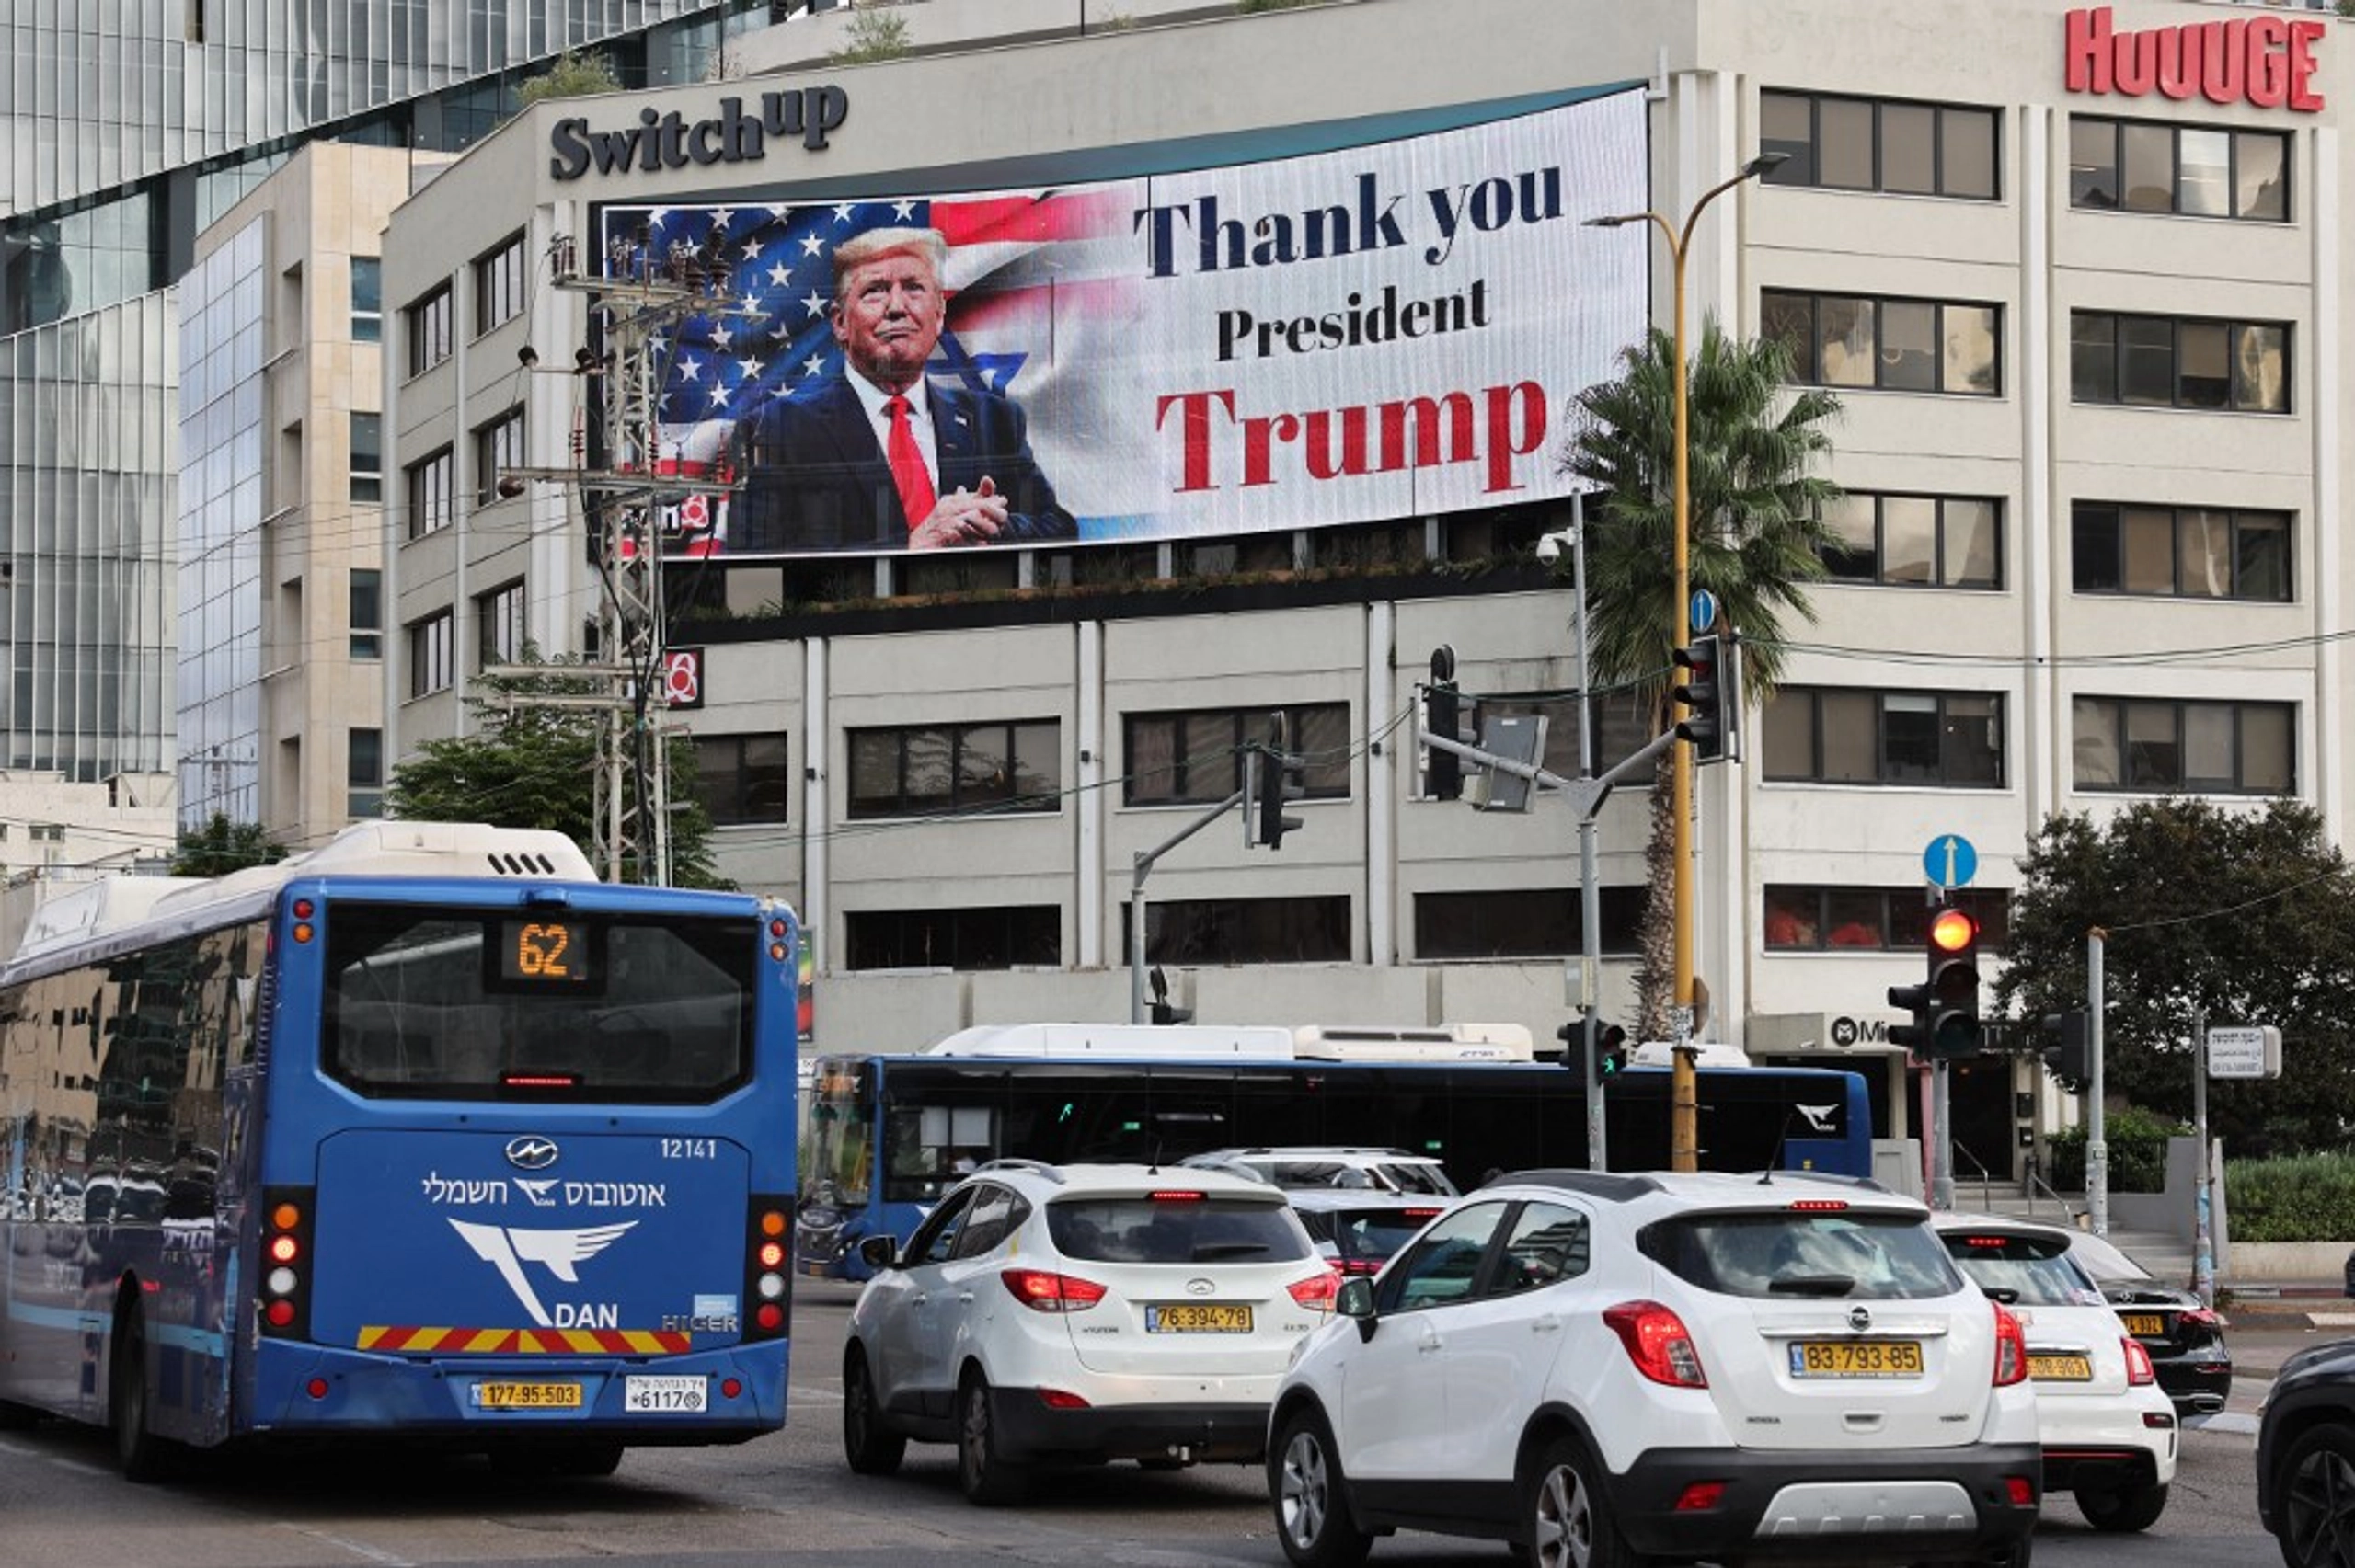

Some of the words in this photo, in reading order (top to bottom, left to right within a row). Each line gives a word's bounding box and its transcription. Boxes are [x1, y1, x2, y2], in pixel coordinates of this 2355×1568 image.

[550, 85, 849, 181] Switchup
[1133, 172, 1407, 280] Thank
[1425, 166, 1565, 267] you
[1216, 279, 1492, 362] President
[1156, 379, 1548, 494] Trump
[520, 924, 568, 975] 62
[661, 1139, 717, 1159] 12141
[422, 1171, 507, 1204] חשמלי
[564, 1182, 666, 1207] אוטובוס
[556, 1303, 618, 1329] DAN
[662, 1315, 738, 1332] HIGER
